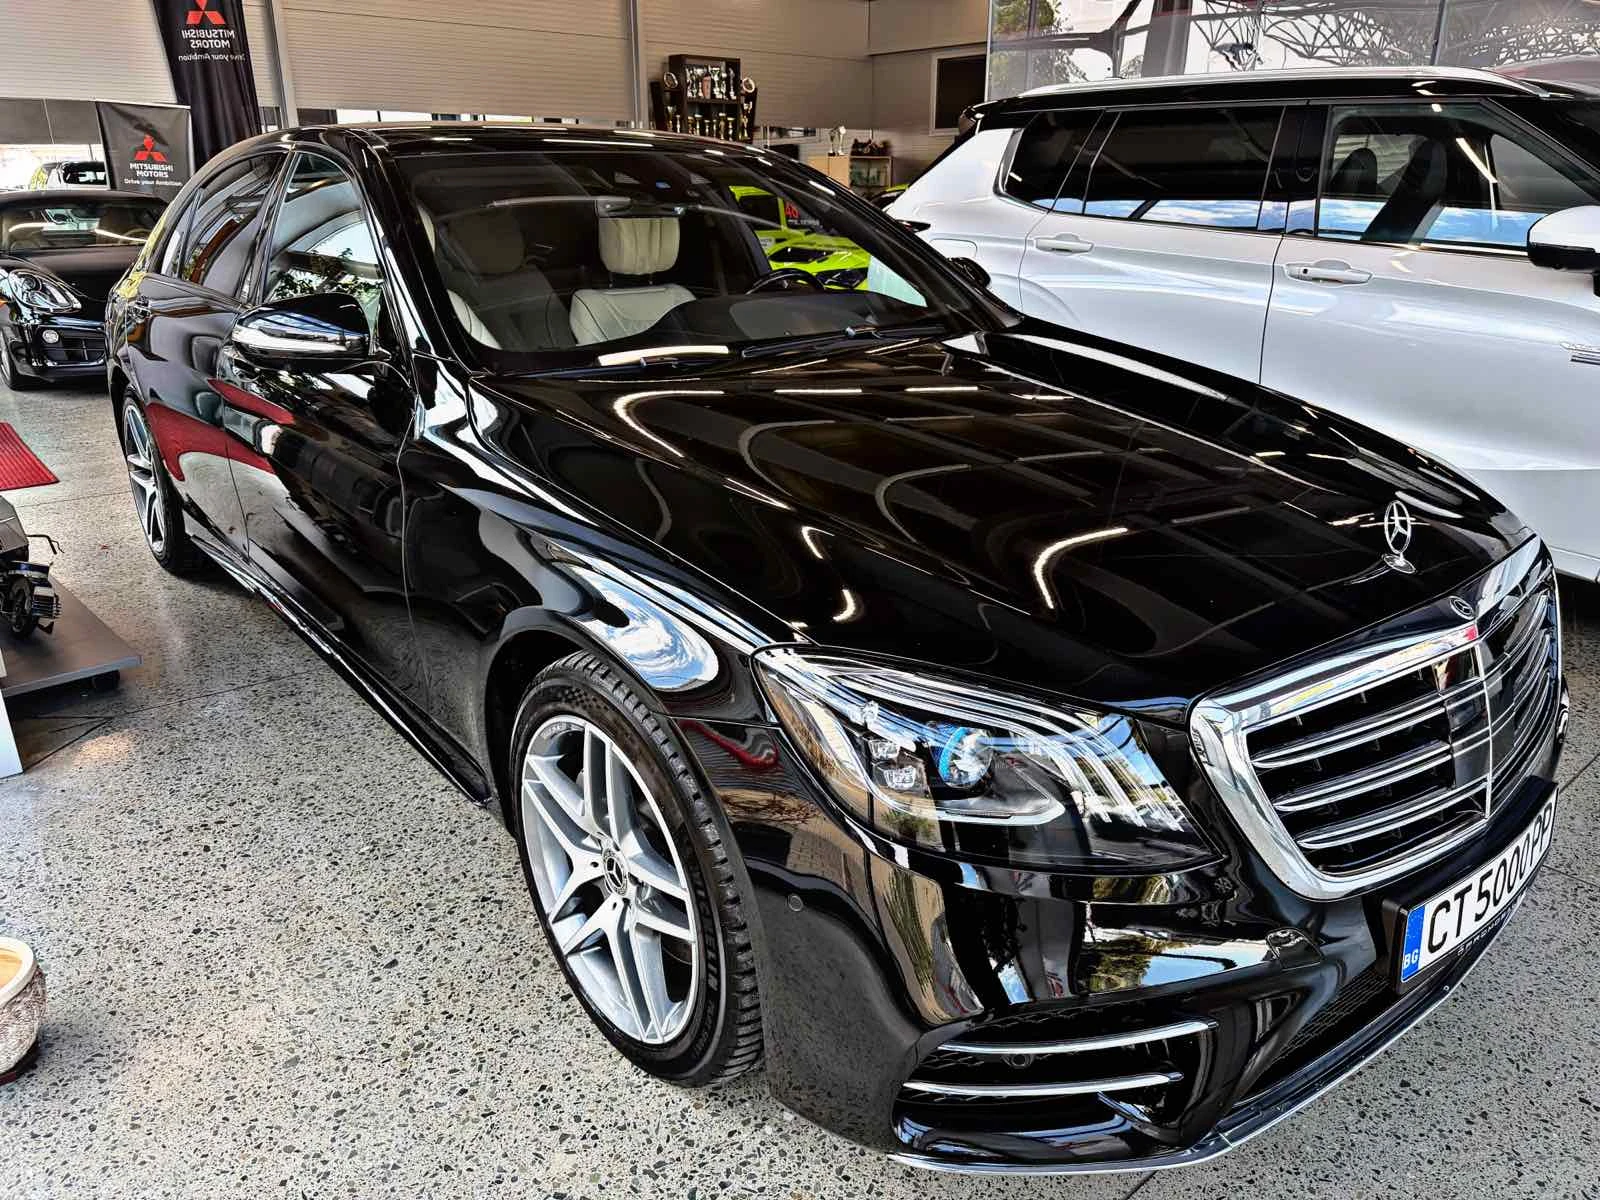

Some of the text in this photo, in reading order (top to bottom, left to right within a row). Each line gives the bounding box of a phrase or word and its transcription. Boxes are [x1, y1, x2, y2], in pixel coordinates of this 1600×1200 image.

[129, 162, 174, 172] MITSUBISHI
[136, 170, 169, 178] MOTORS
[1403, 949, 1420, 970] BG
